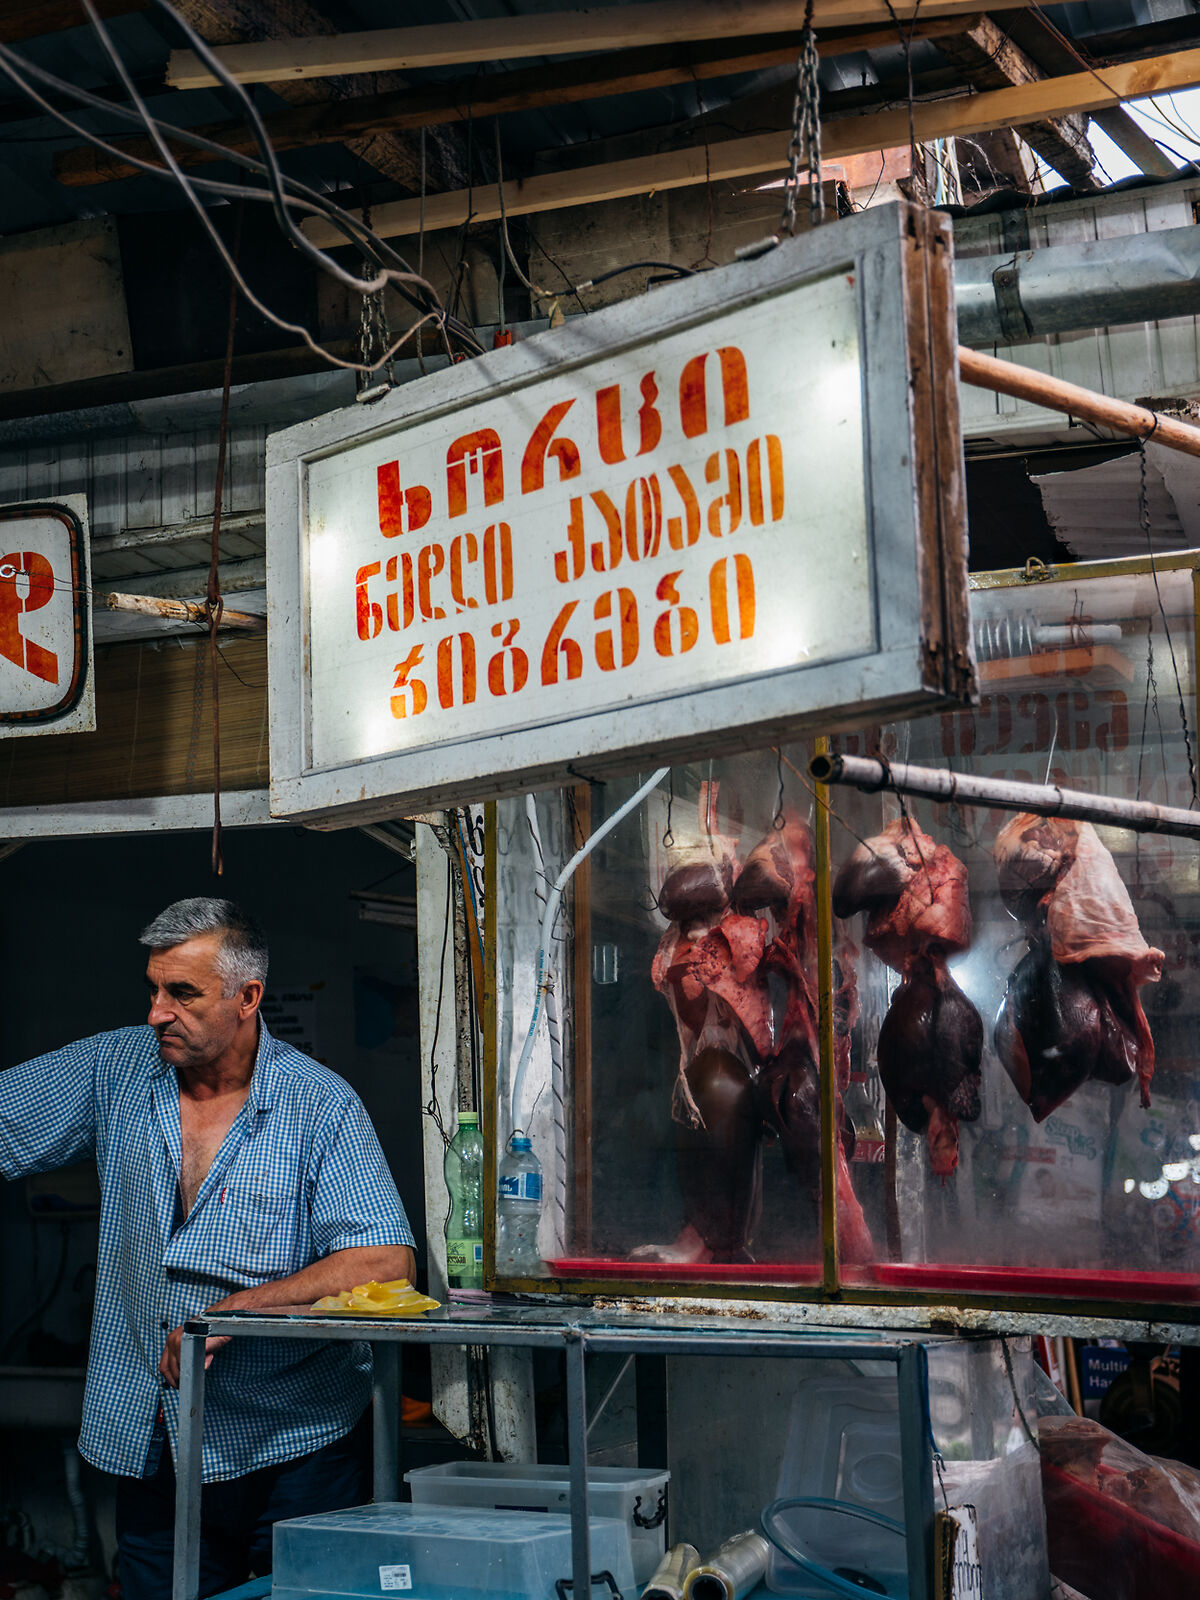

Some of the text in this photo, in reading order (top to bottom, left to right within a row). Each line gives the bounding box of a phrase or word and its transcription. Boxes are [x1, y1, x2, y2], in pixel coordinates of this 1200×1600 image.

[355, 433, 785, 641] ნედლი ქათამი
[376, 345, 750, 539] ხორცი
[389, 552, 756, 720] ჯიგრები
